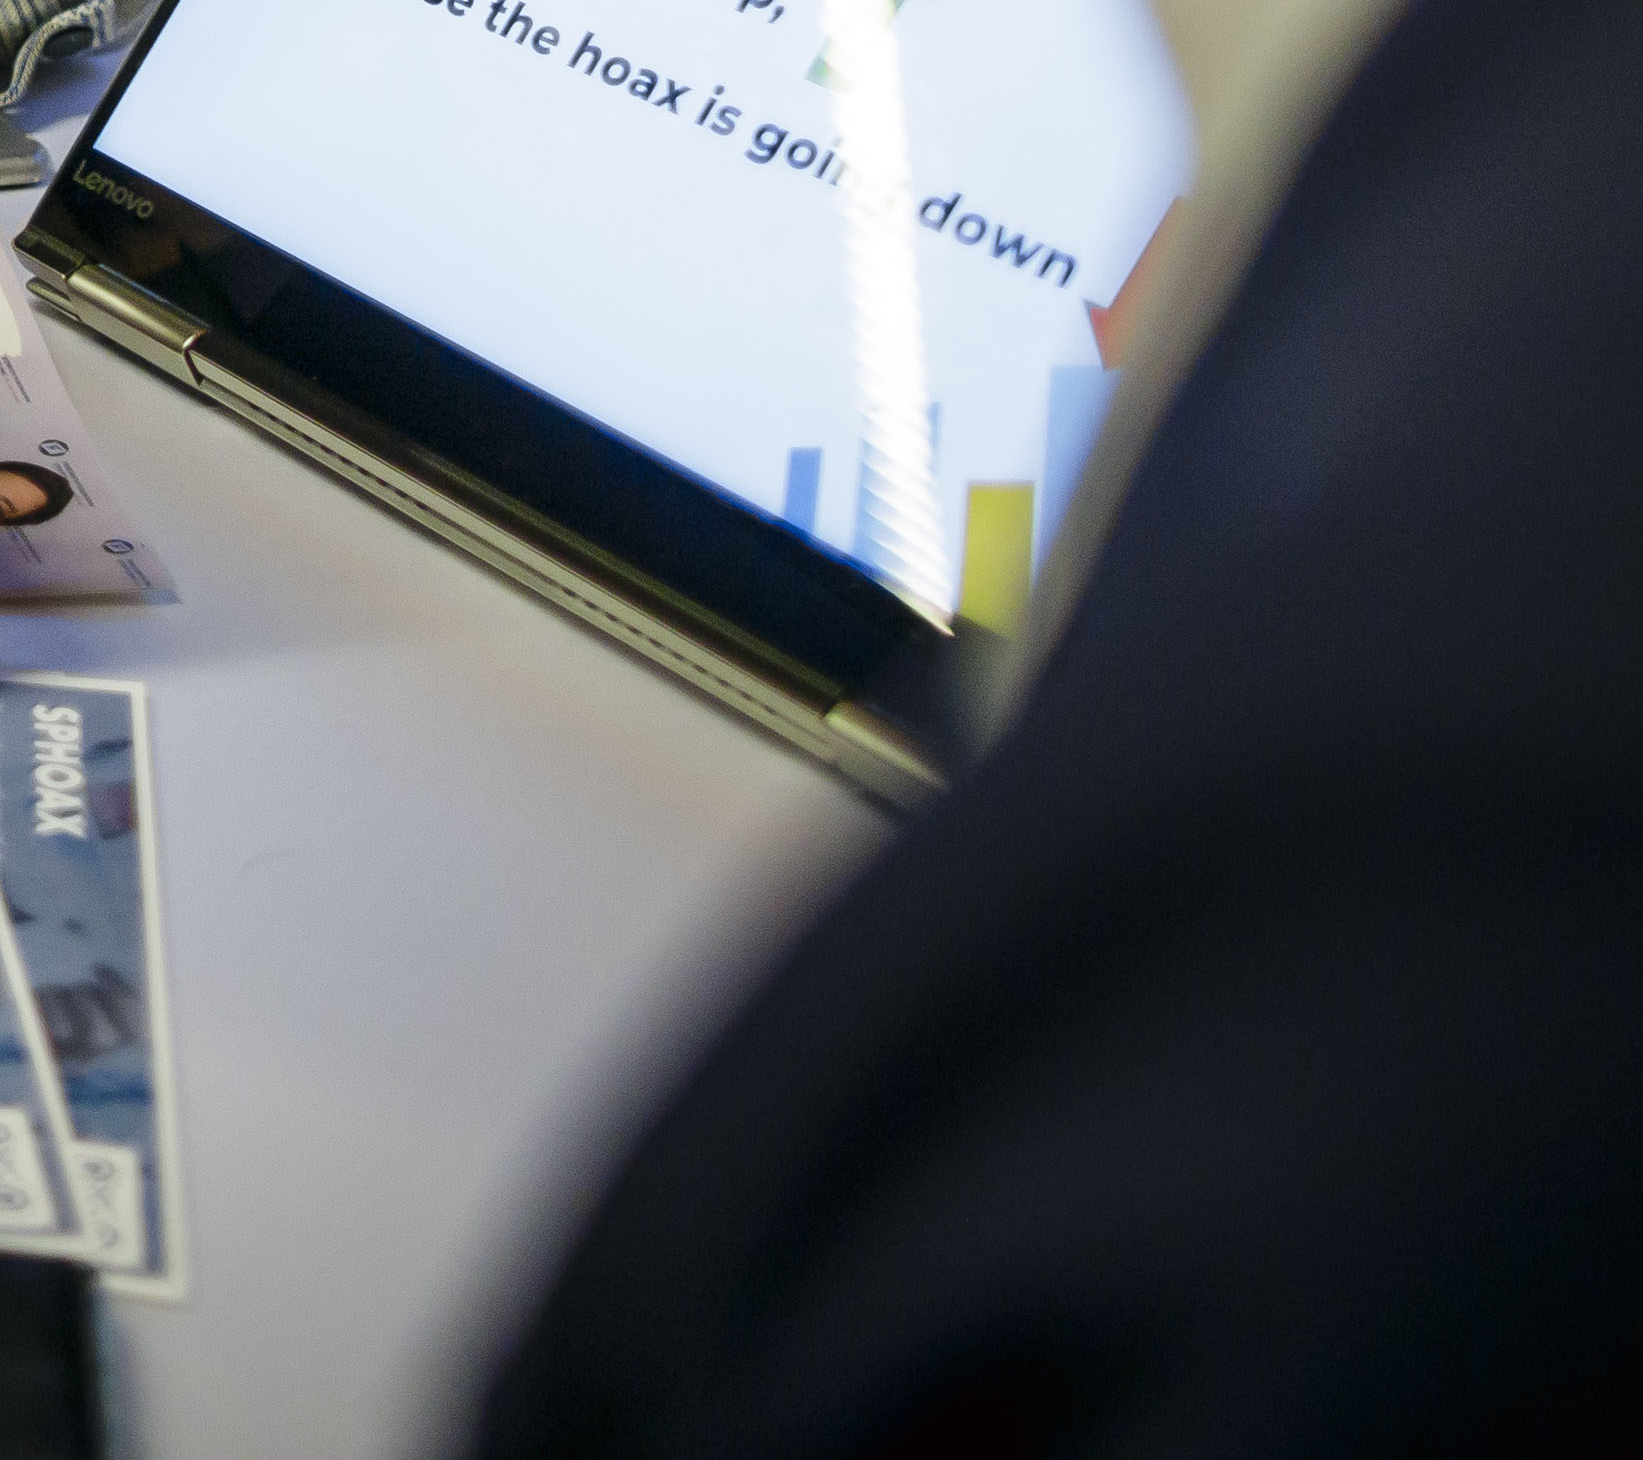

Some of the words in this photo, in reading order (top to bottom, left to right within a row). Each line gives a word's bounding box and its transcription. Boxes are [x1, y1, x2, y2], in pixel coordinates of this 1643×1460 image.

[73, 159, 155, 219] Lenovo
[567, 31, 692, 115] hoax
[695, 84, 743, 136] is
[745, 122, 874, 199] goi
[917, 191, 1079, 288] down
[31, 705, 85, 838] SPHOAX
